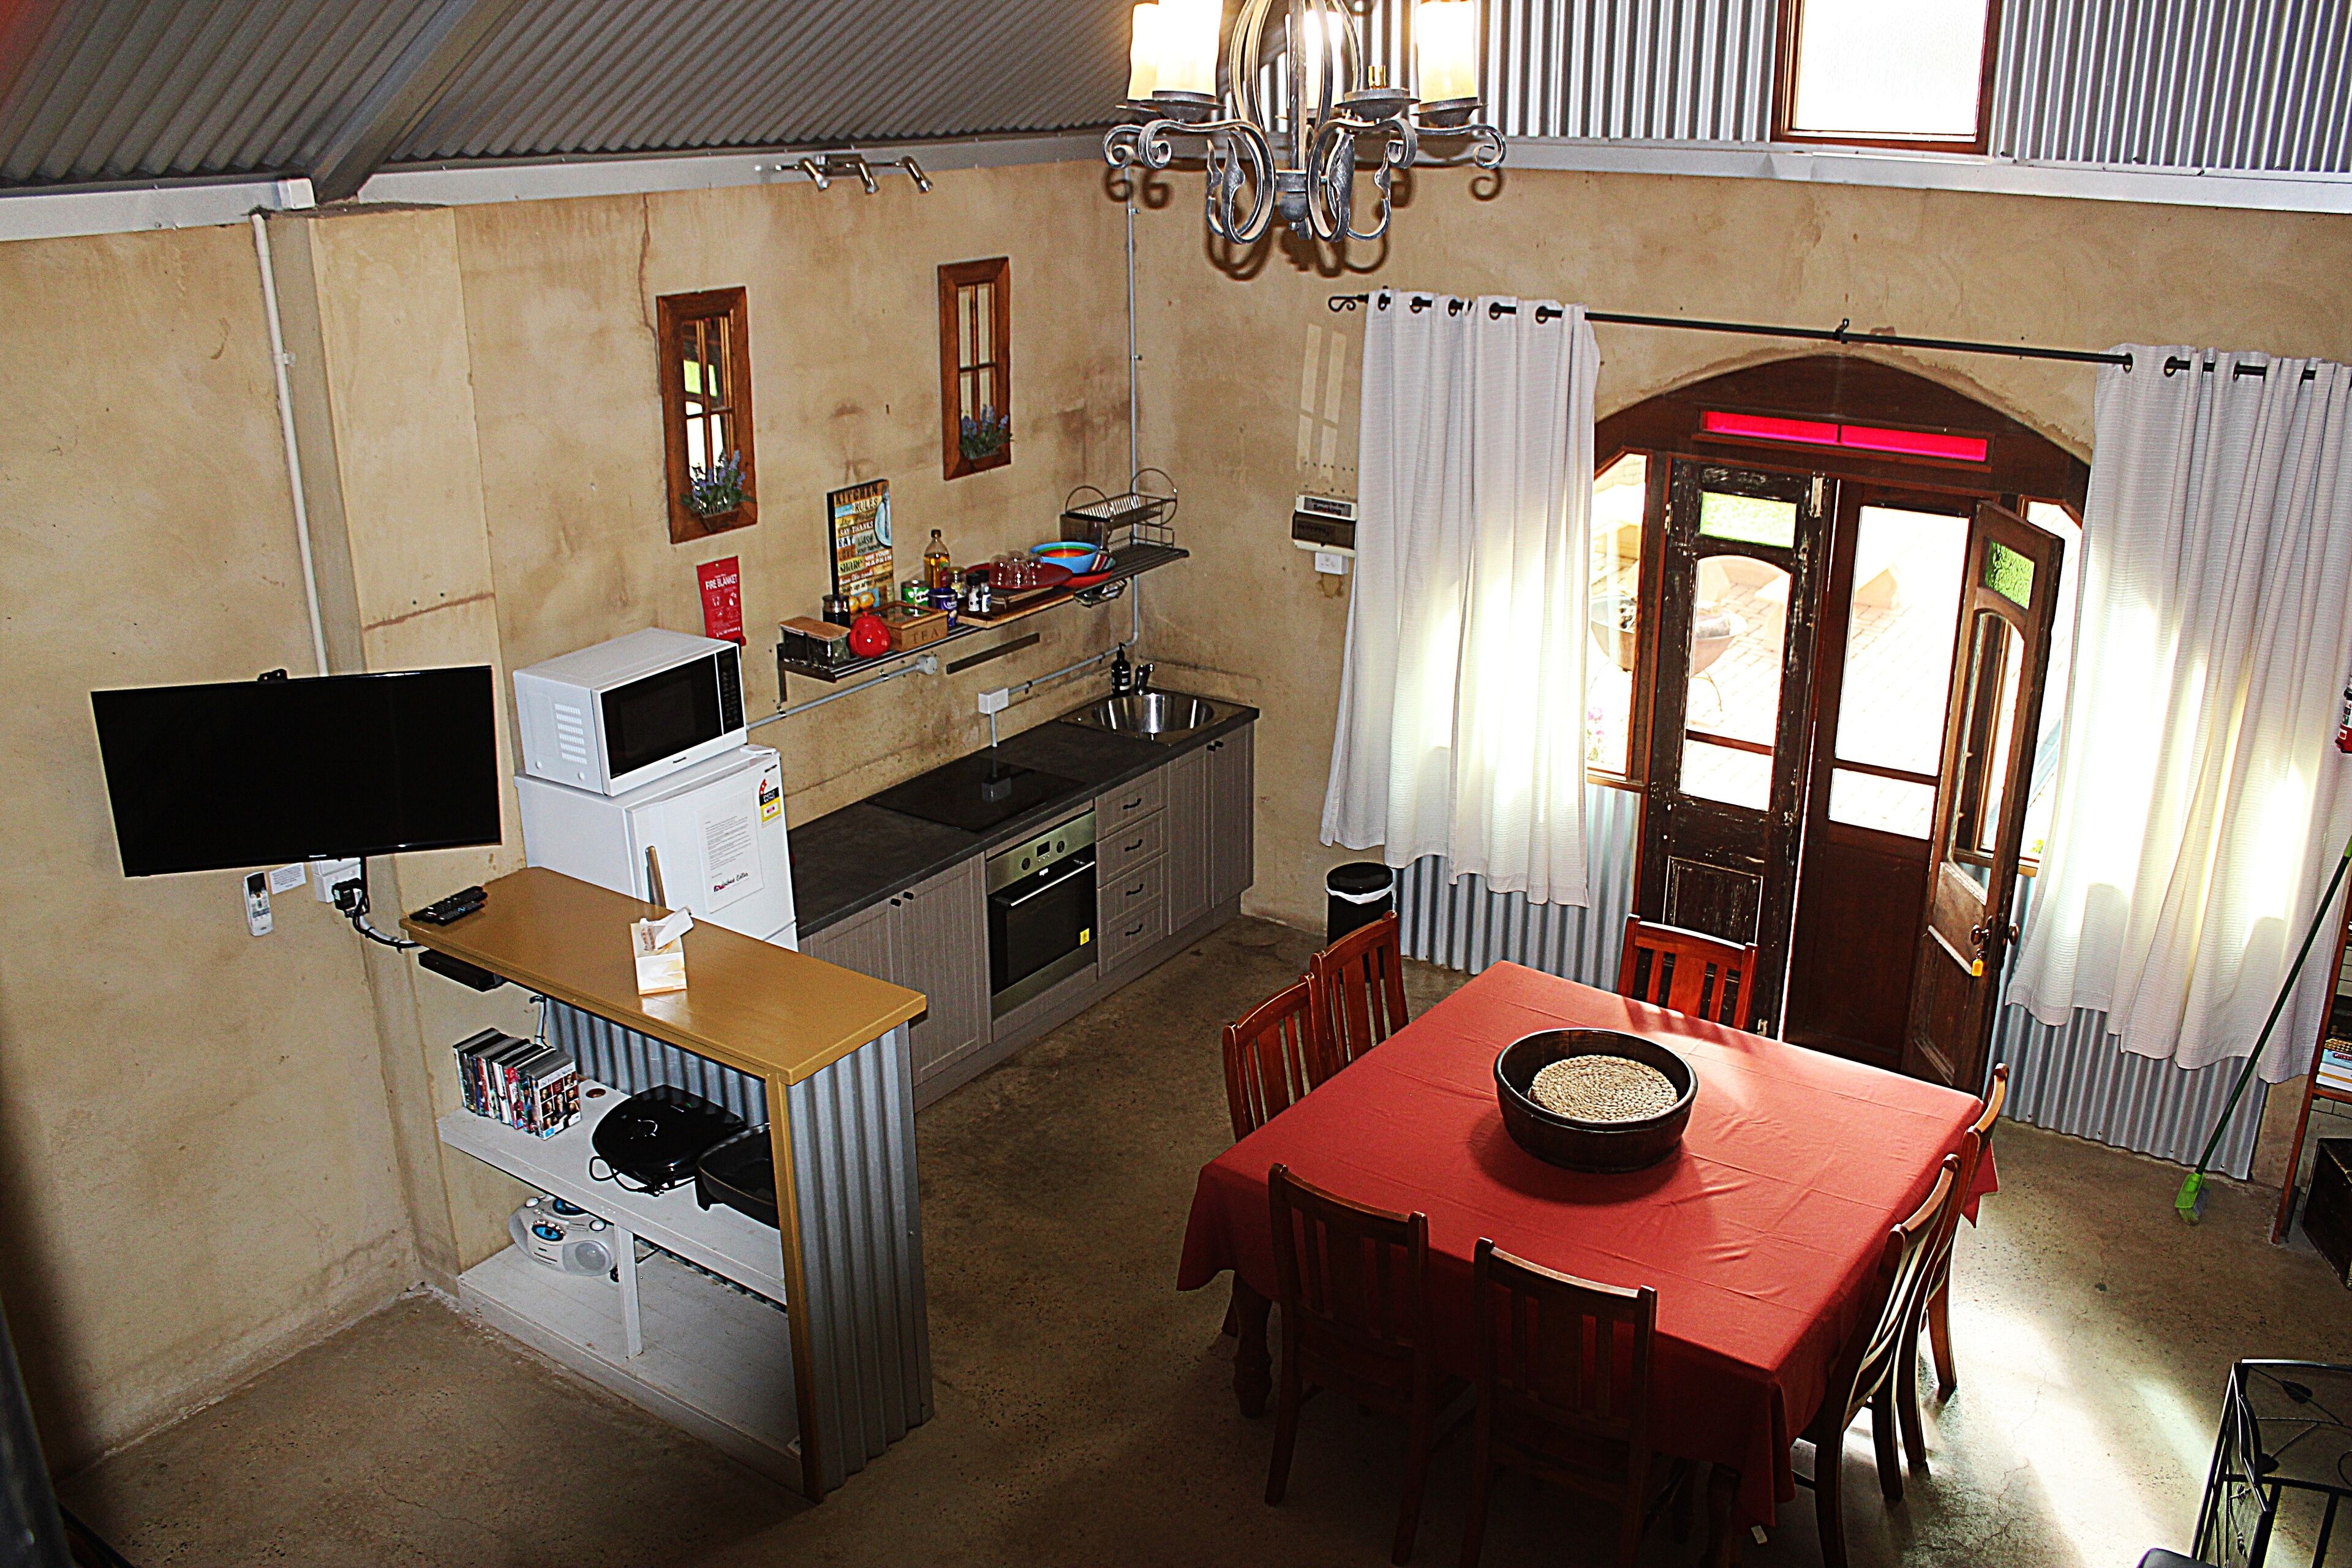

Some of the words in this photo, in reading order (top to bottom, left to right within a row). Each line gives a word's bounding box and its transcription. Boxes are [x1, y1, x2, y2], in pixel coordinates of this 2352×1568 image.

[834, 483, 877, 505] KITCHEN
[854, 497, 878, 512] RULES
[840, 527, 850, 536] SAY
[852, 521, 874, 533] THANKS
[838, 535, 853, 548] EAT
[865, 554, 892, 568] NAPKIN
[705, 579, 717, 590] FIRE
[717, 573, 737, 588] BLANKET
[912, 628, 939, 644] TEA
